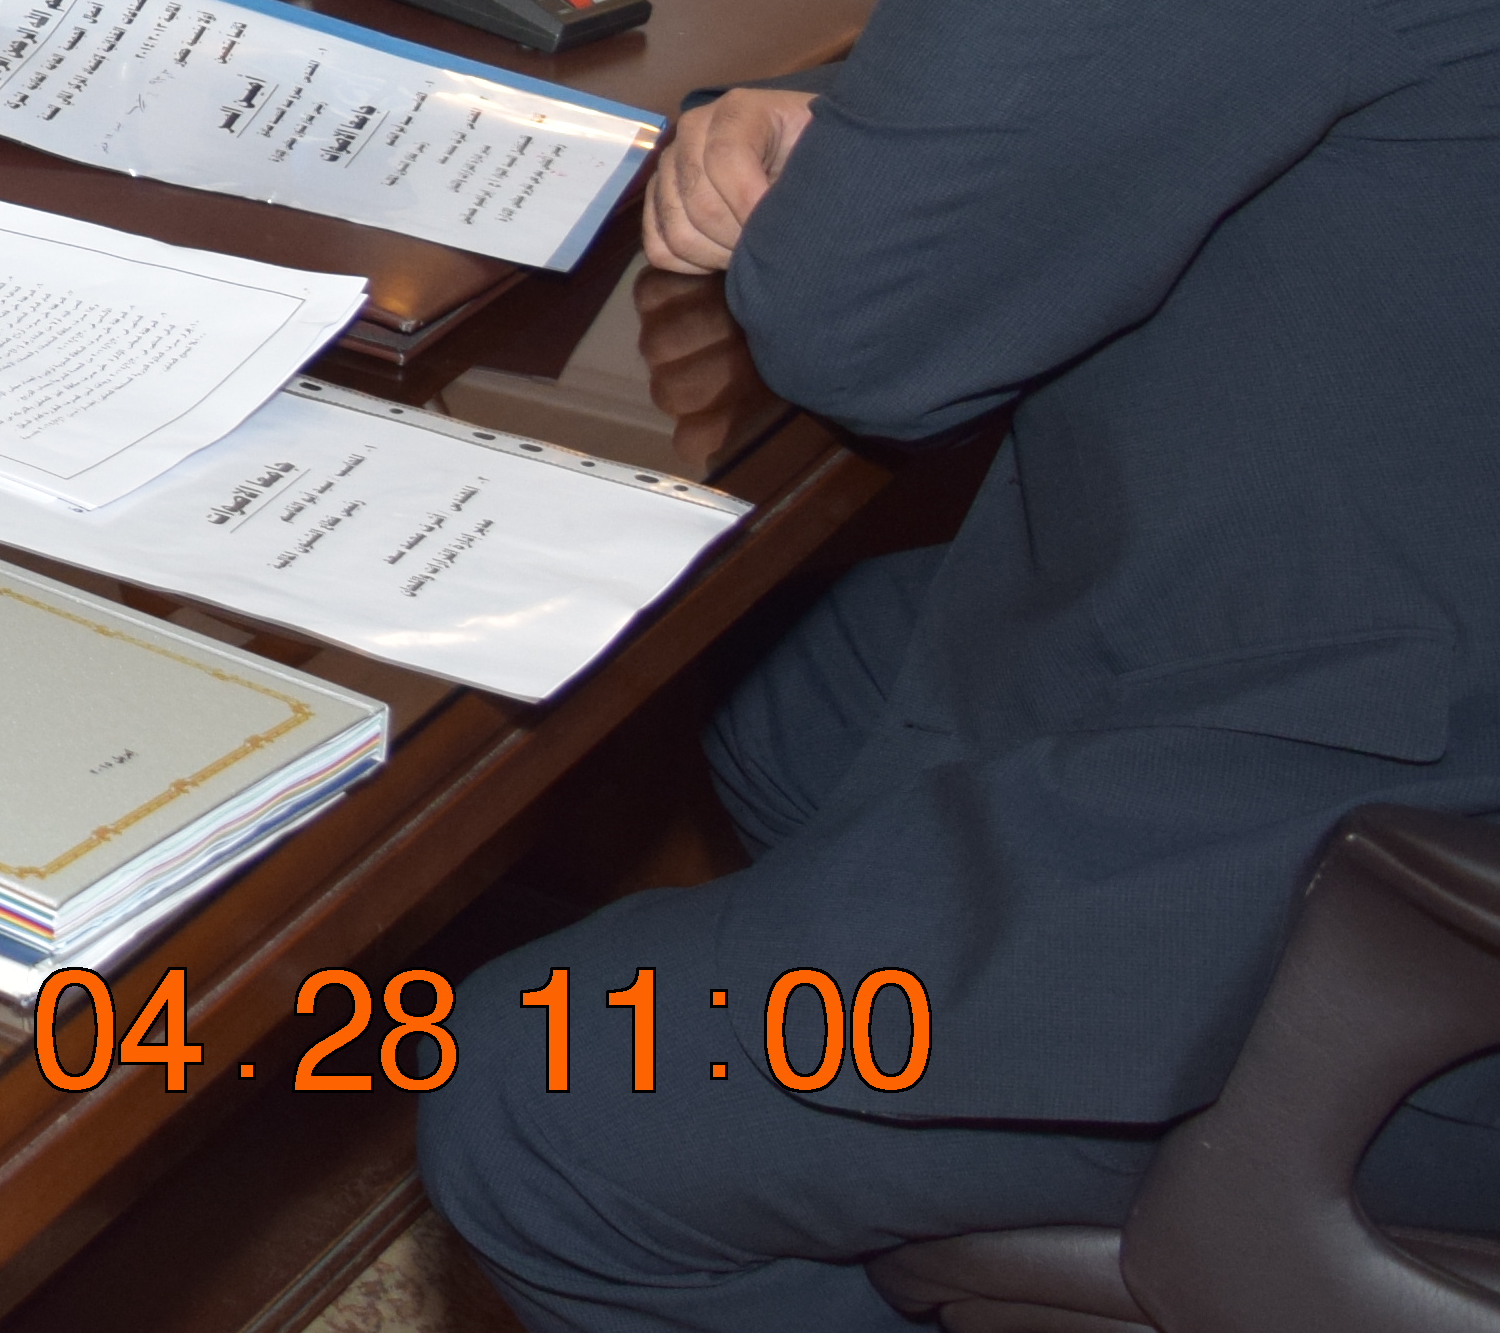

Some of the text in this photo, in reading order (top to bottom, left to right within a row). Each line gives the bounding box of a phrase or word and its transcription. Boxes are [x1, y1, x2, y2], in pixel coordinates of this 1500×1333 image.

[24, 8, 53, 29] الله
[83, 1, 104, 25] أعمال
[3, 26, 39, 59] الرحمن
[63, 26, 86, 52] الجمعية
[102, 26, 126, 53] الغذائية
[46, 53, 65, 71] العامة
[174, 48, 192, 68] حضور
[218, 75, 266, 134] أمين السر
[340, 105, 380, 131] جامعا
[207, 462, 299, 525] جامعا الاصوات
[450, 485, 480, 512] المهندس
[400, 532, 428, 551] محمد
